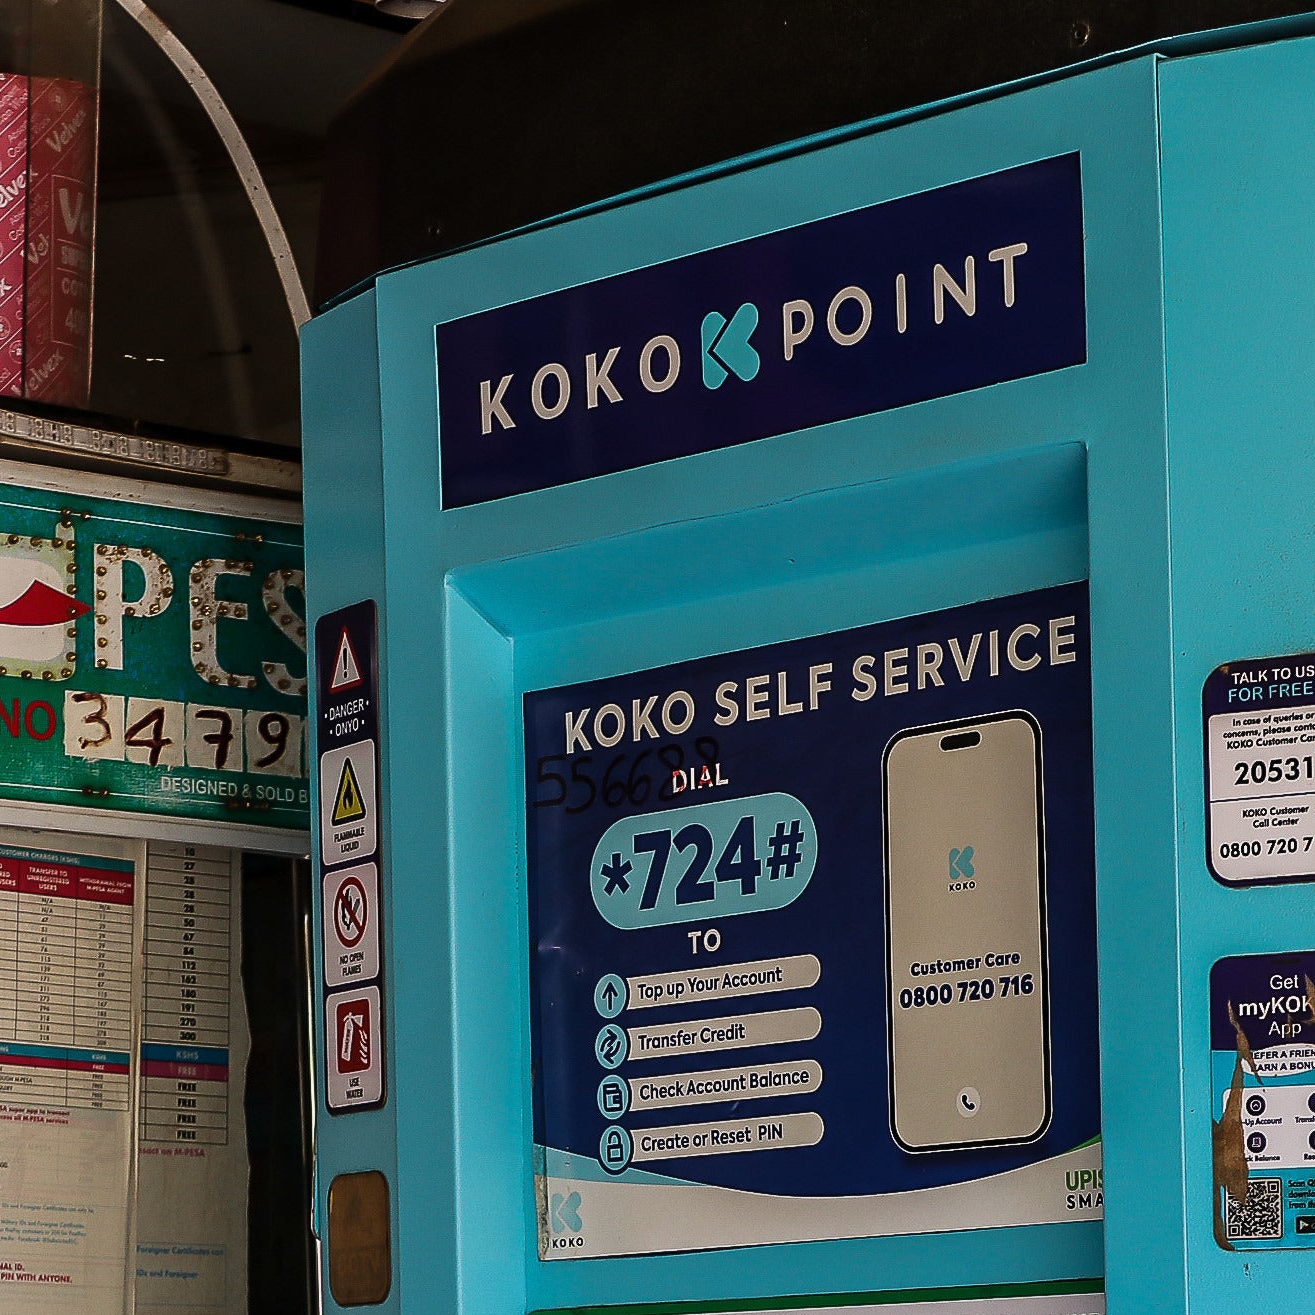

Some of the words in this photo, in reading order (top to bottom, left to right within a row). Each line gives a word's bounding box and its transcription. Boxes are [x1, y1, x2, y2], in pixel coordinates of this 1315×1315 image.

[480, 335, 682, 435] KOKO
[782, 242, 1028, 361] POINT
[1231, 669, 1268, 684] TALK
[1272, 667, 1291, 681] TO
[1295, 665, 1315, 678] US
[564, 691, 695, 755] KOKO
[715, 663, 833, 727] SELF
[853, 616, 1077, 701] SERVICE
[1228, 687, 1263, 703] FOR
[329, 698, 365, 721] DANGER
[72, 692, 290, 769] 3479
[335, 718, 359, 735] ONYO
[1232, 718, 1241, 727] In
[1263, 725, 1291, 737] please
[1227, 740, 1254, 750] KOKO
[1256, 736, 1298, 747] Customer
[672, 763, 729, 793] DIAL
[1234, 756, 1313, 785] 20531
[160, 776, 238, 797] DESIGNED
[256, 785, 295, 801] SOLD
[1242, 808, 1267, 818] KOKO
[1269, 806, 1310, 816] Customer
[1253, 819, 1270, 828] Call
[1271, 818, 1300, 827] Center
[334, 827, 365, 843] FLAMMABLE
[340, 842, 359, 854] LIQUID
[1220, 841, 1261, 858] 0800
[1266, 838, 1298, 854] 720
[948, 881, 976, 893] KOKO
[687, 929, 721, 954] TO
[910, 956, 982, 978] Customer
[985, 950, 1021, 970] Care
[637, 983, 664, 1002] Top
[666, 981, 683, 998] up
[685, 975, 720, 995] Your
[722, 966, 783, 988] Account
[1270, 974, 1298, 990] Get
[899, 984, 952, 1010] 0800
[957, 979, 995, 1003] 720
[998, 974, 1033, 998] 716
[637, 1029, 698, 1051] Transfer
[700, 1023, 746, 1045] Credit
[1268, 1021, 1302, 1038] App
[1254, 1050, 1279, 1060] EFER
[1280, 1050, 1287, 1058] A
[1257, 1063, 1278, 1072] ARN
[1280, 1062, 1287, 1070] A
[639, 1082, 685, 1102] Check
[686, 1075, 746, 1097] Account
[748, 1067, 810, 1090] Balance
[640, 1132, 690, 1153] Create
[692, 1133, 709, 1148] or
[710, 1126, 751, 1146] Reset
[759, 1123, 783, 1142] PIN
